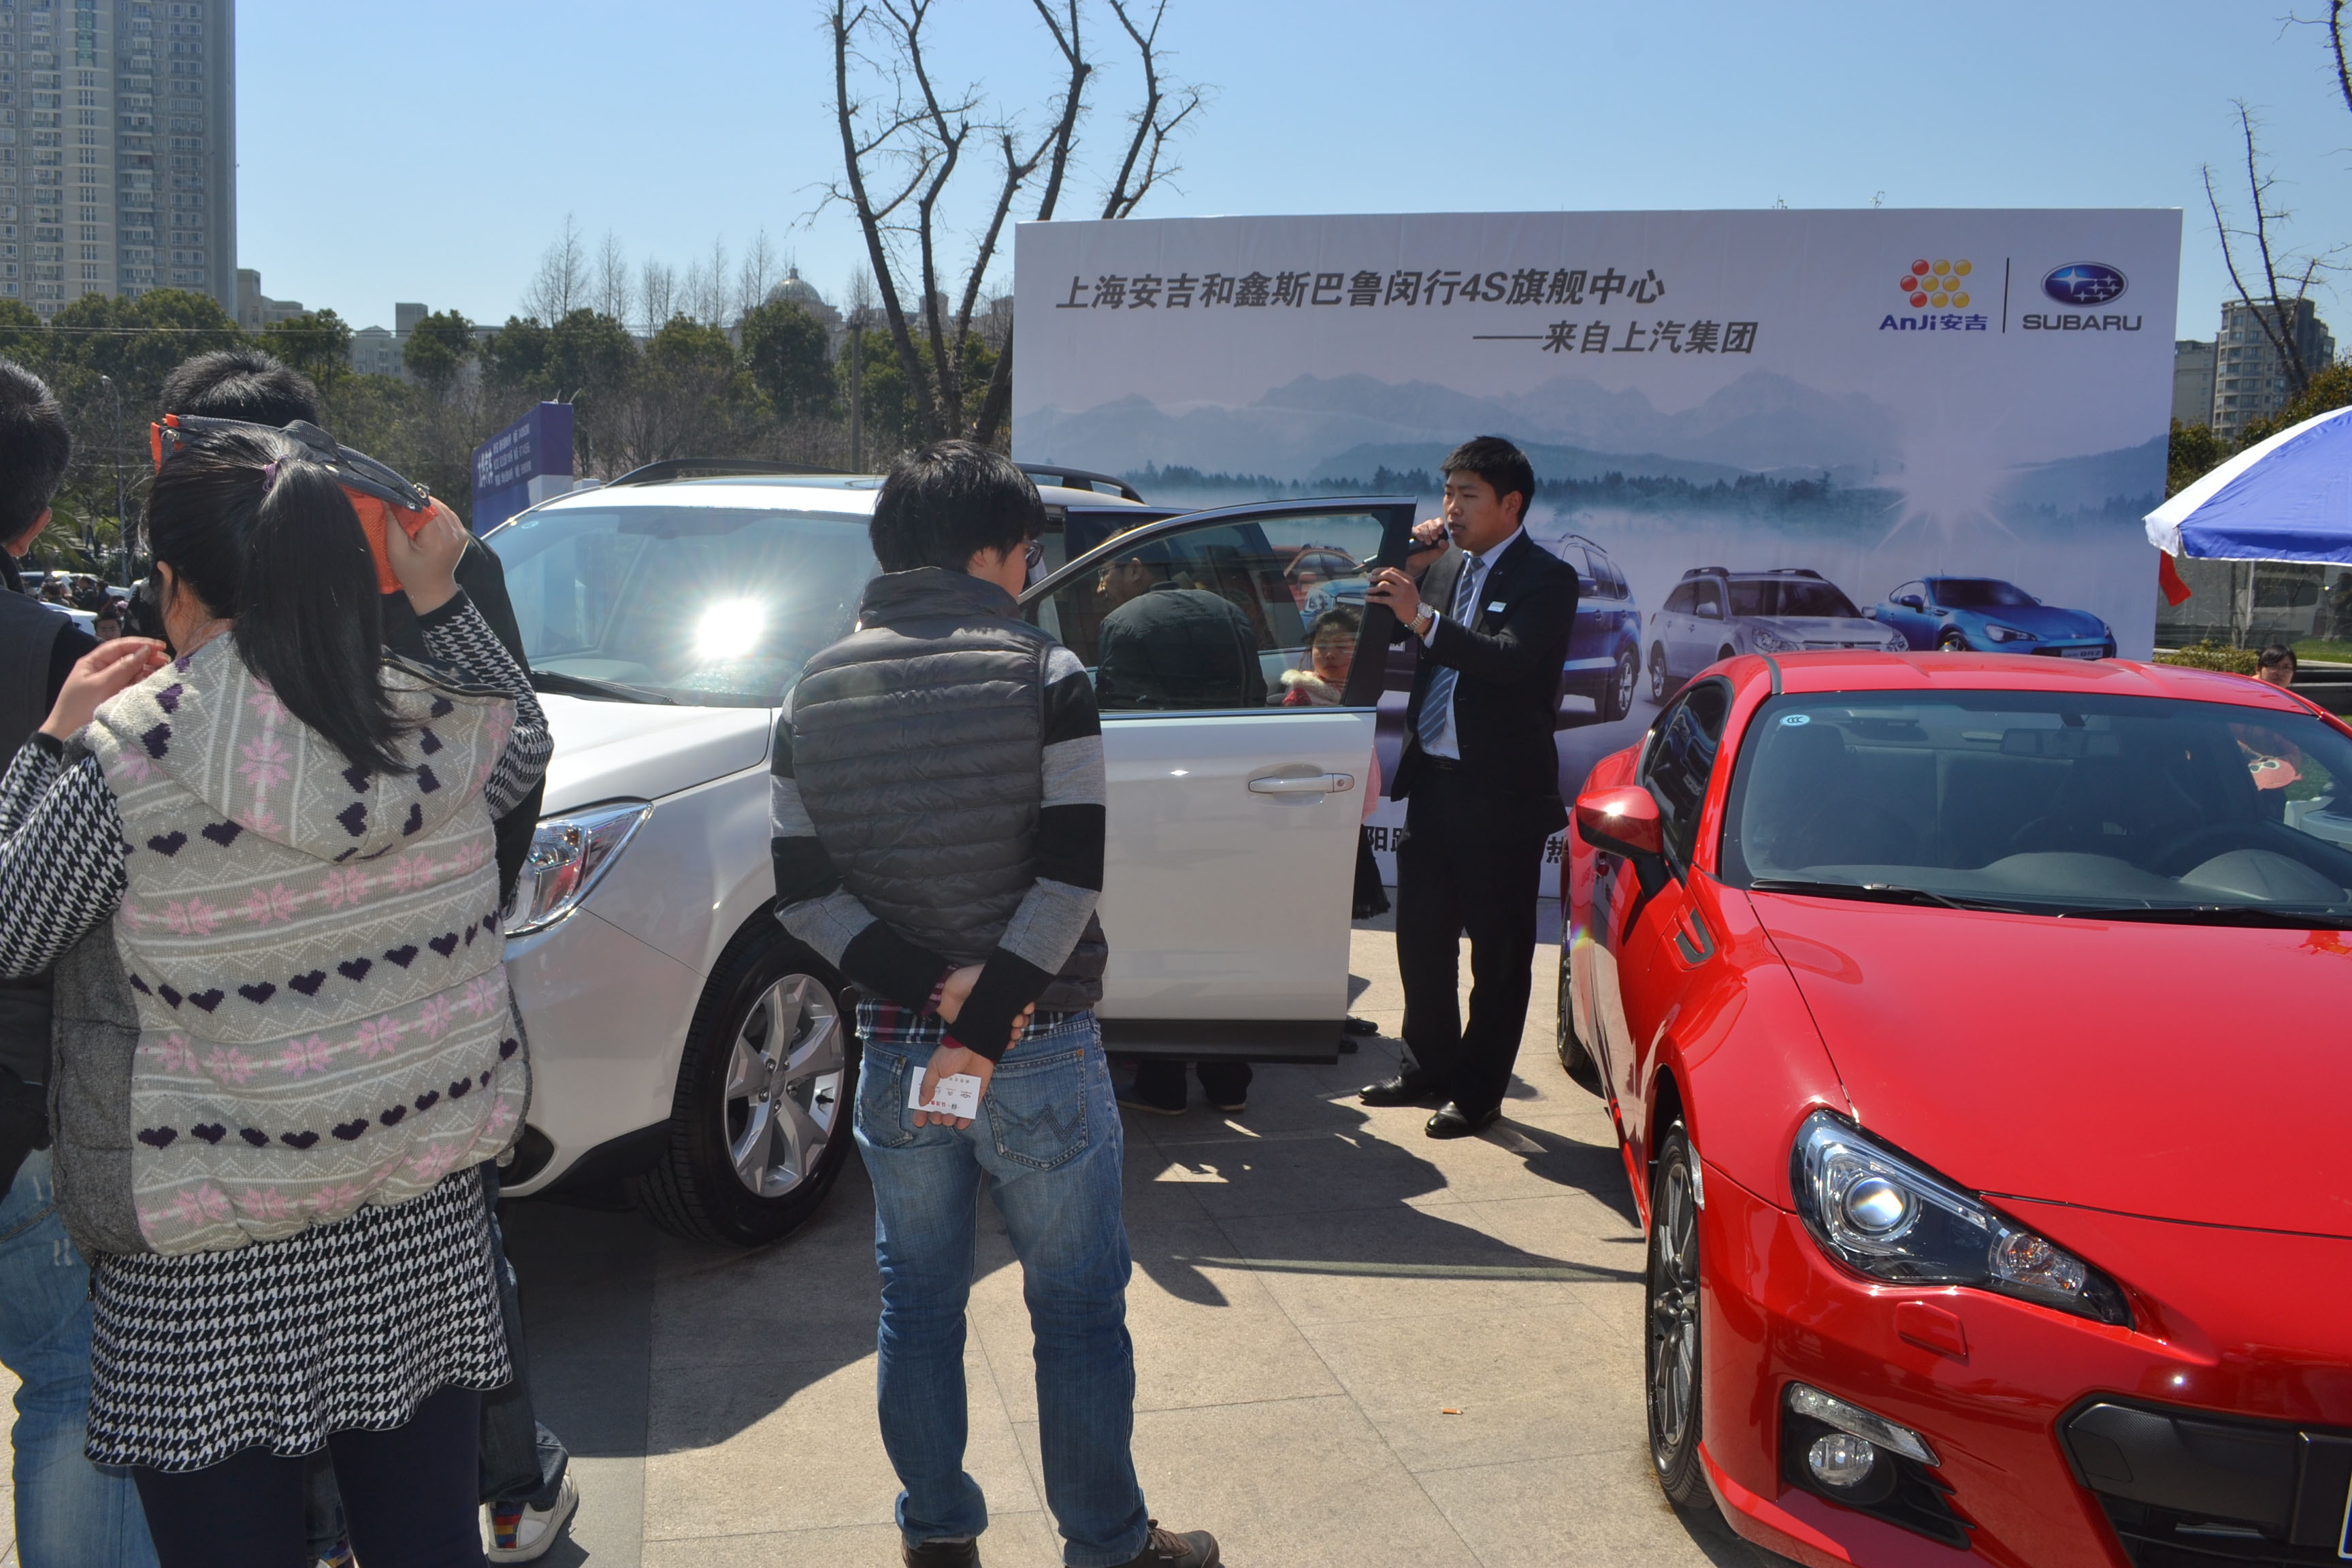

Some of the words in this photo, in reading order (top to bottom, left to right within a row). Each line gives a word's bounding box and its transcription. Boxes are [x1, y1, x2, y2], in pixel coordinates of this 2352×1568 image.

[1056, 267, 1665, 309] 上海安吉和鑫斯巴鲁闵行4S旗舰中心
[2022, 314, 2142, 331] SUBARU
